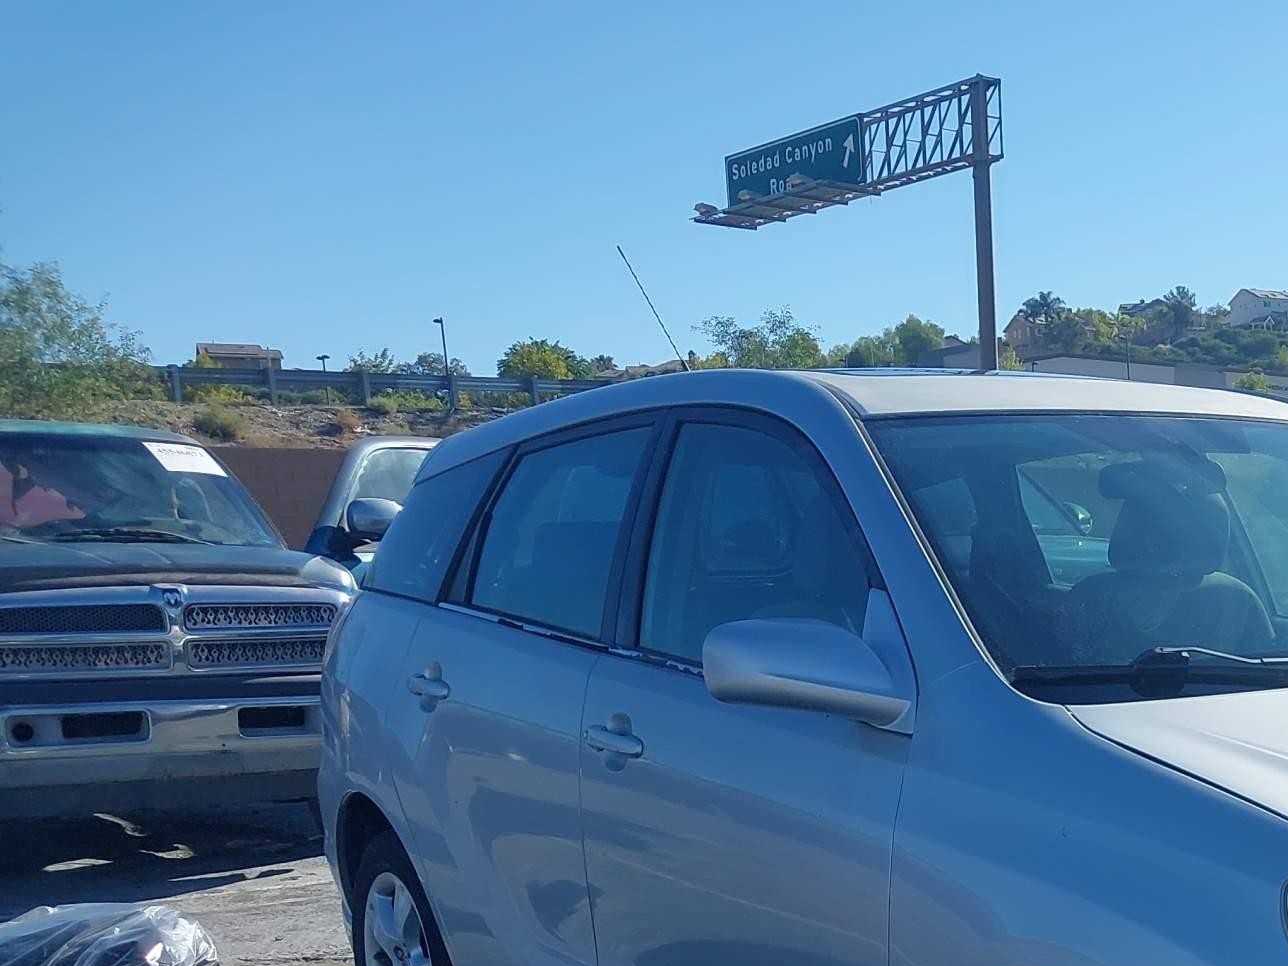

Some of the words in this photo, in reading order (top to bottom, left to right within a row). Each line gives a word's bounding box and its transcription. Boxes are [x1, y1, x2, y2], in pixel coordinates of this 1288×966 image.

[732, 149, 780, 180] Soledad
[785, 137, 833, 163] Canyon
[770, 178, 792, 195] Roa
